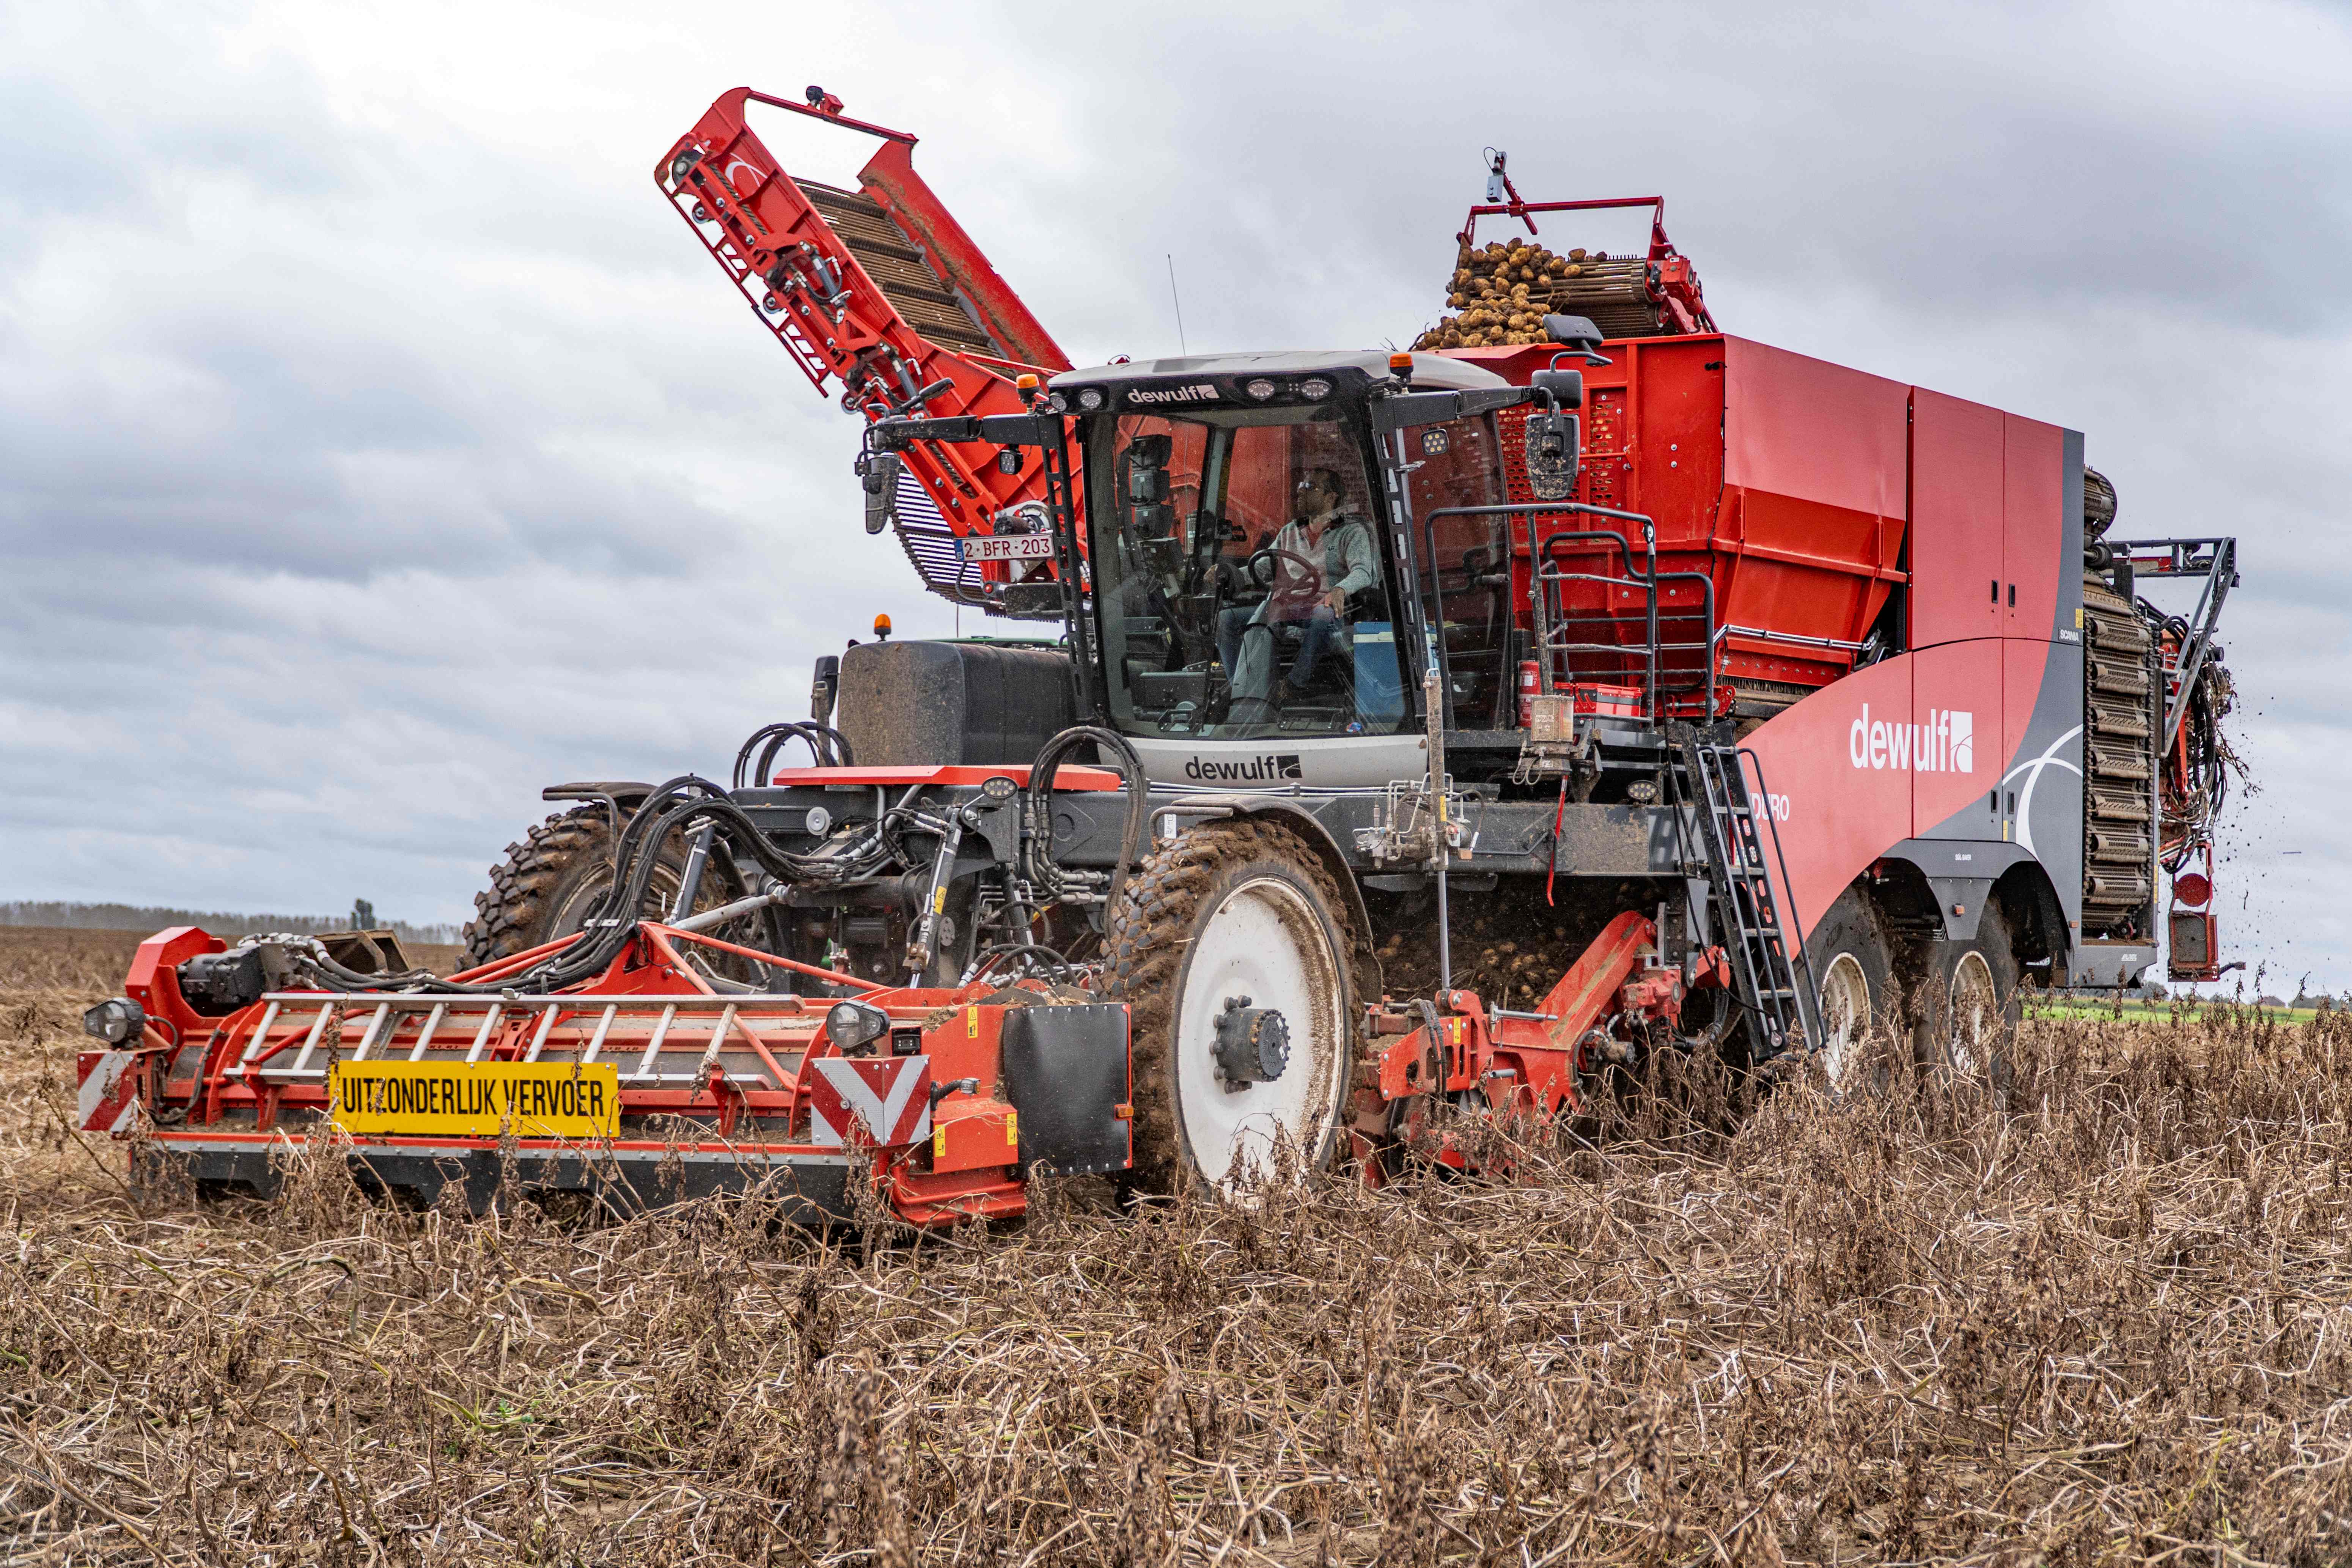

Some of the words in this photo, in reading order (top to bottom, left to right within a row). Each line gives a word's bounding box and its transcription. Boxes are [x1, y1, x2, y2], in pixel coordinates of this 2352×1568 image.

[1128, 386, 1199, 403] dewulf
[2060, 629, 2079, 642] SCANIA
[1850, 703, 1949, 772] dewulf
[1185, 755, 1275, 780] dewulf
[1750, 793, 1790, 821] DURO
[343, 1077, 498, 1115] UITZONDERLIJK
[504, 1079, 604, 1117] VERVOER
